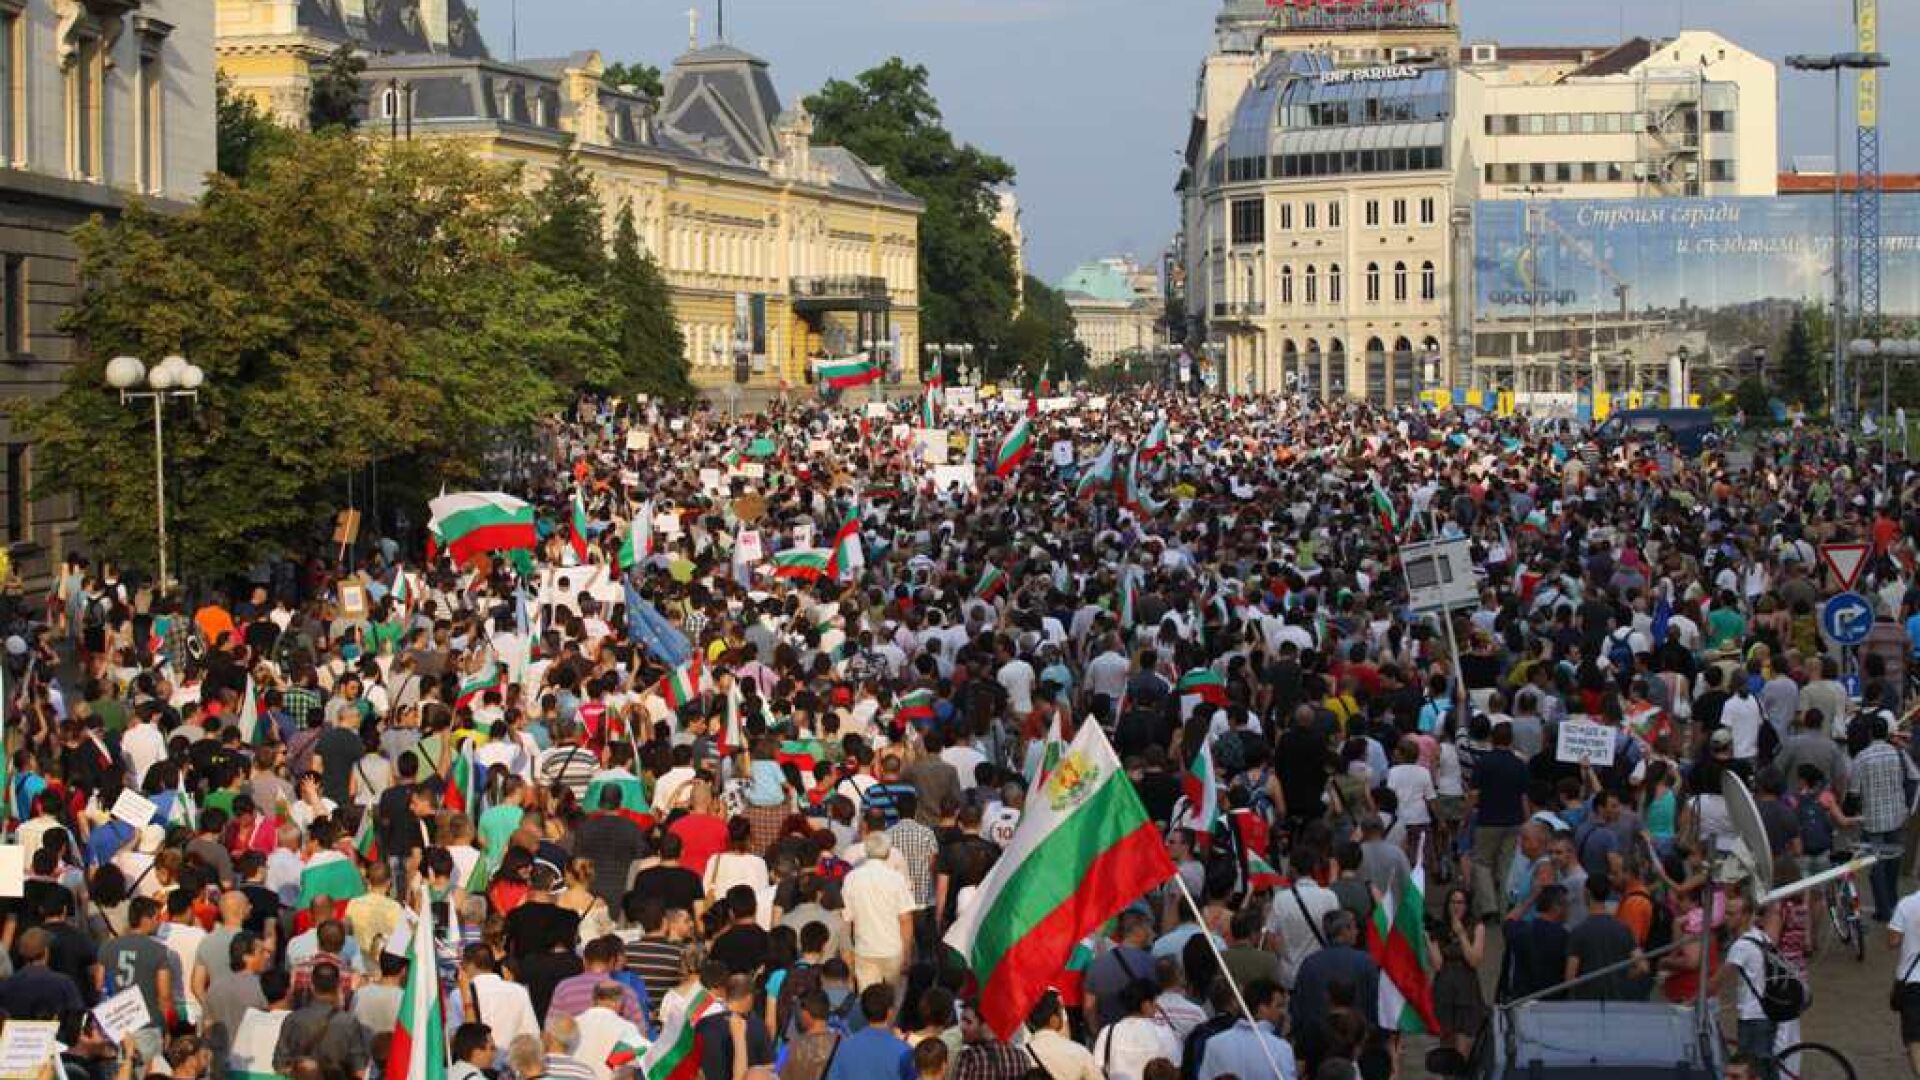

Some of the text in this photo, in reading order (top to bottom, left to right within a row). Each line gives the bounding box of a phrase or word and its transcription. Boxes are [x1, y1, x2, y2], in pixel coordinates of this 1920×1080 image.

[1353, 65, 1419, 81] PARIBAS
[1576, 203, 1665, 231] Строим
[996, 826, 1014, 840] 10
[117, 949, 137, 987] 5
